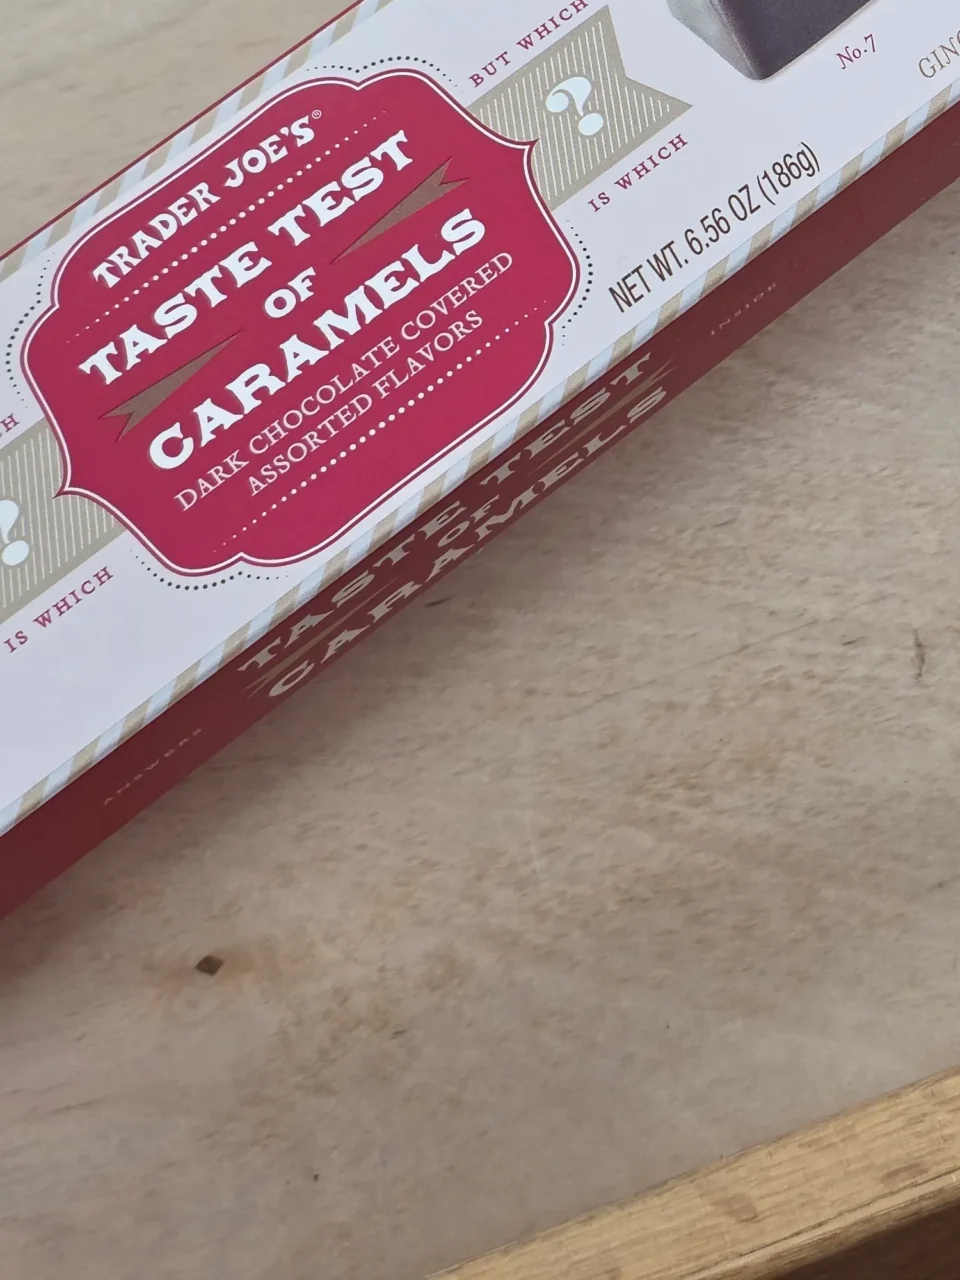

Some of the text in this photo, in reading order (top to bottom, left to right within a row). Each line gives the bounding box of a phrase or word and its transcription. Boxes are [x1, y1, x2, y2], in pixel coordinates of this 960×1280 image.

[469, 51, 512, 88] BUT
[836, 34, 877, 69] No.7
[92, 182, 221, 288] TRADER
[587, 134, 688, 213] IS WHICH
[608, 142, 821, 313] NET WT. 6.56 OZ (186g)
[78, 129, 413, 386] TASTE TEST
[264, 267, 316, 318] OF
[149, 208, 485, 469] CARAMELS
[174, 252, 513, 511] DARK CHOCOLATE COVERED
[248, 309, 483, 496] ASSORTED FLAVORS
[237, 352, 651, 671] TASTE TEST
[268, 386, 667, 698] CARAMELS
[438, 494, 499, 547] OF
[4, 566, 113, 653] IS WHICH
